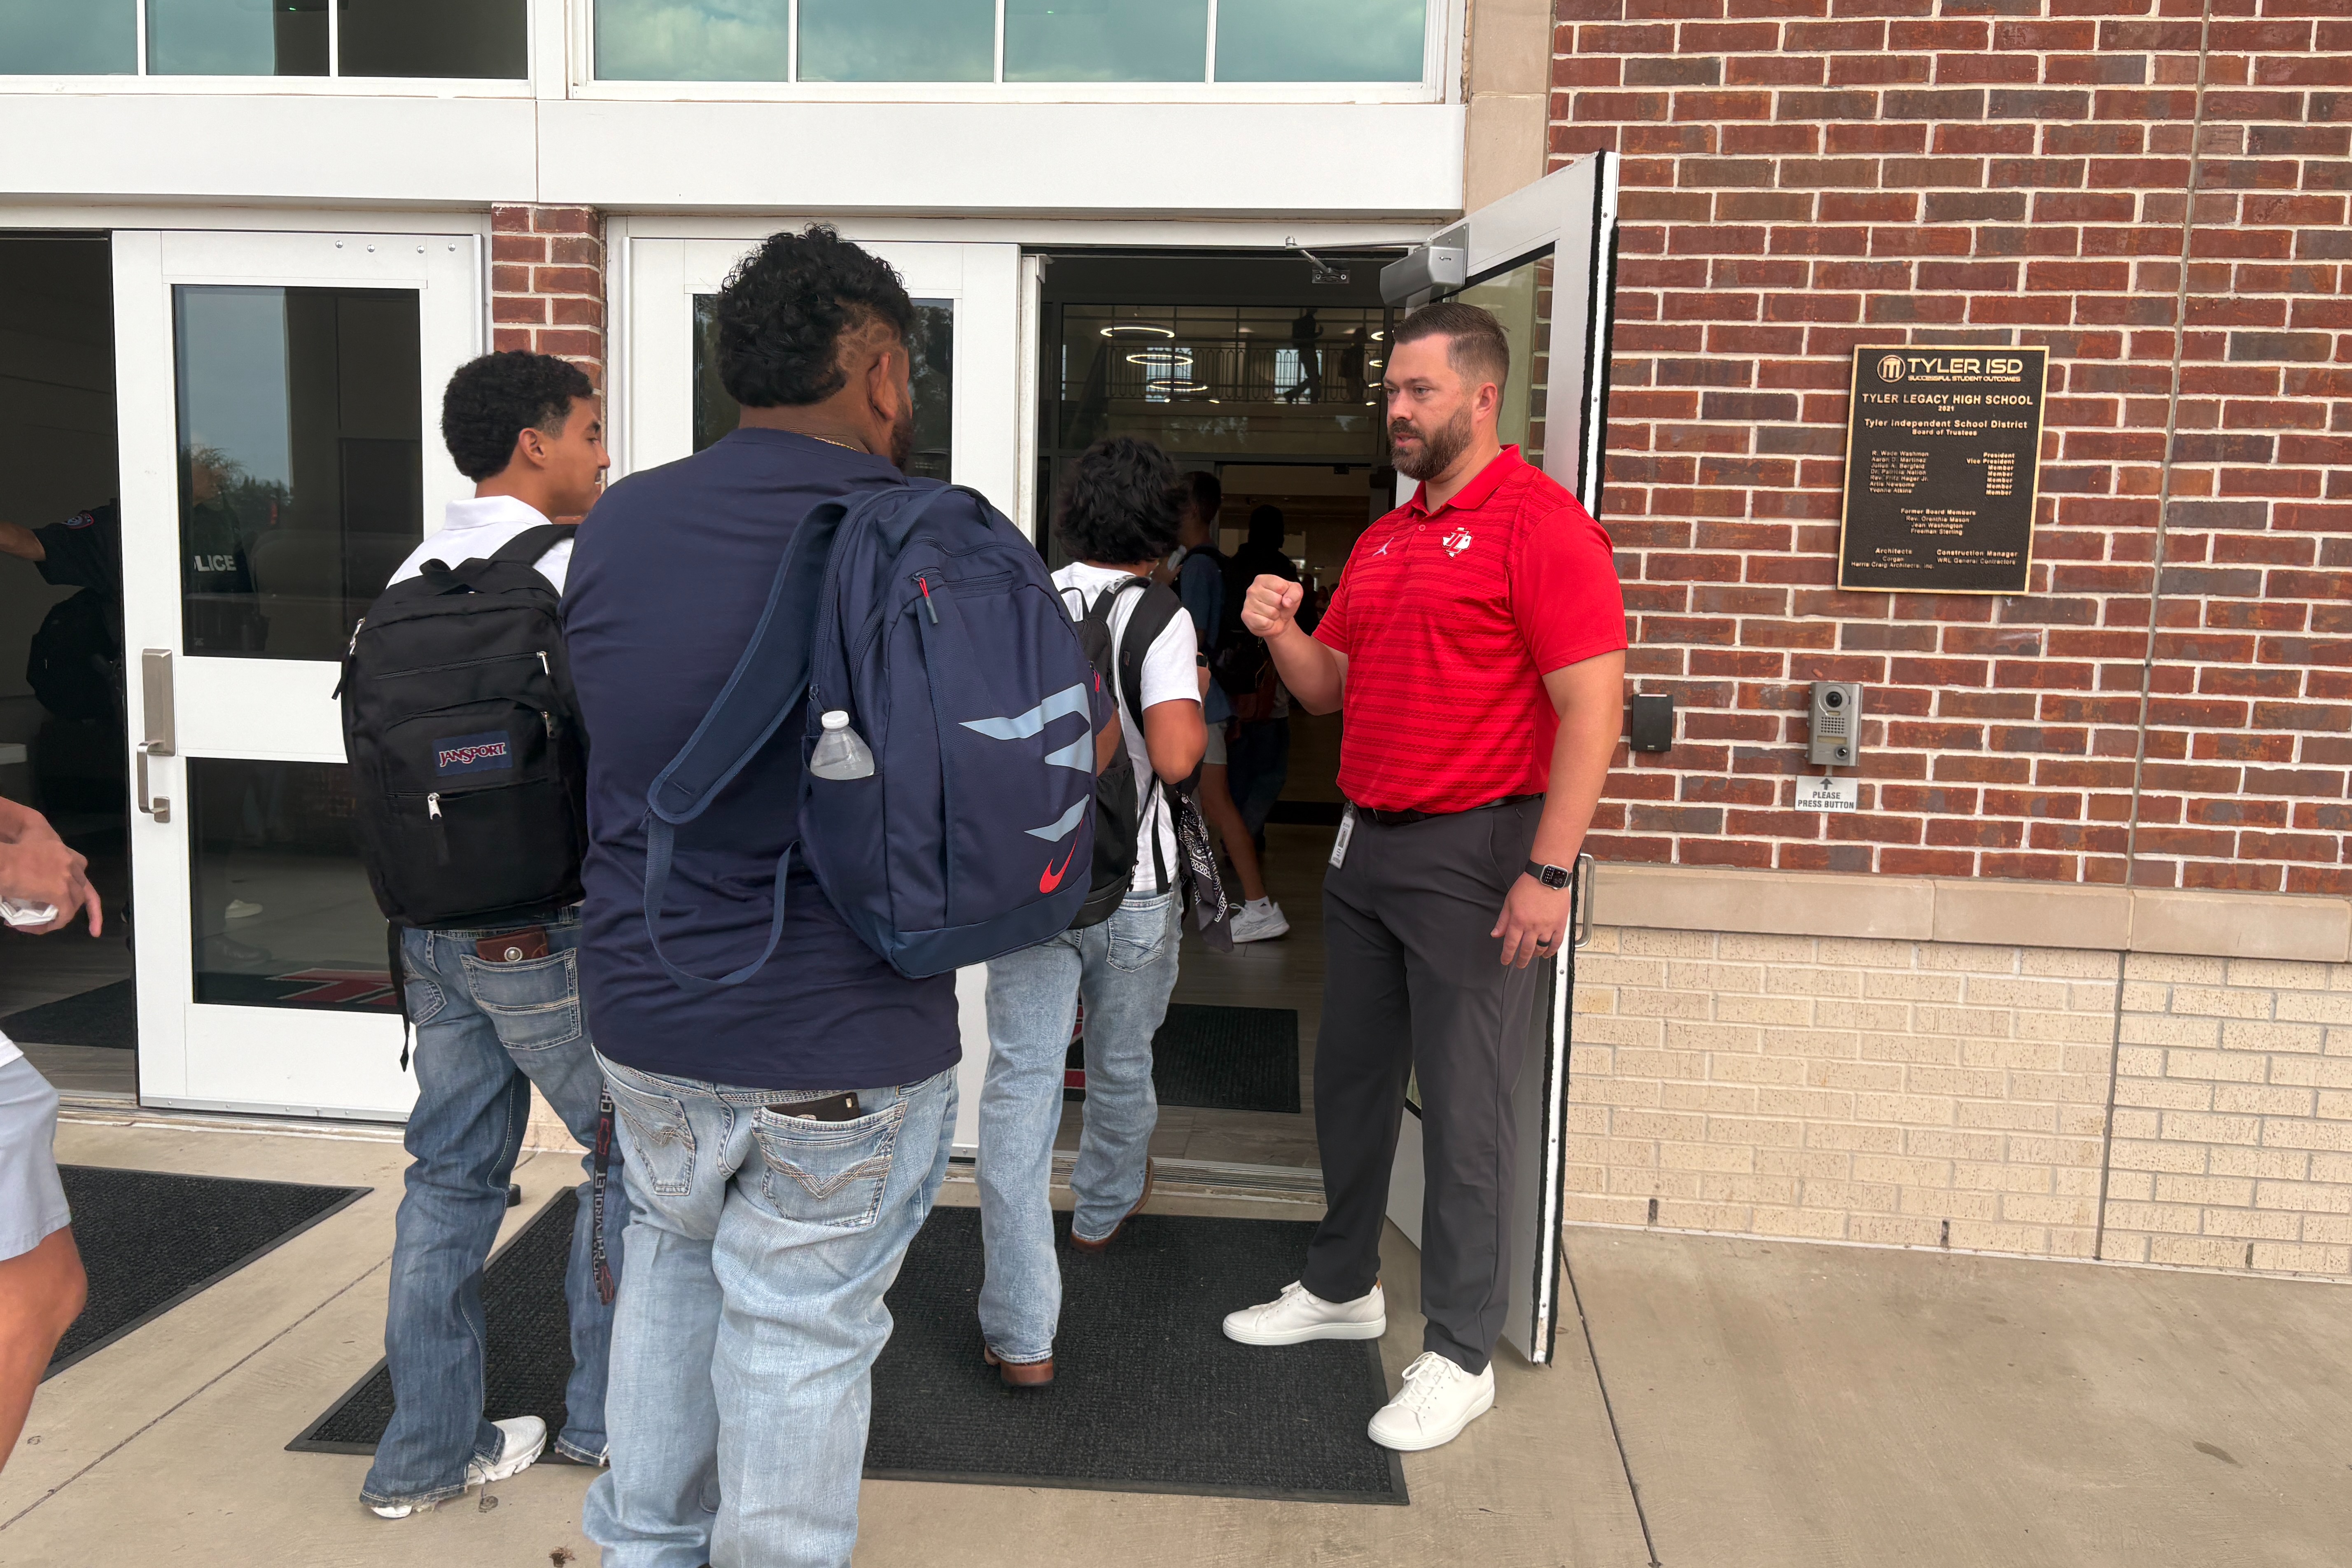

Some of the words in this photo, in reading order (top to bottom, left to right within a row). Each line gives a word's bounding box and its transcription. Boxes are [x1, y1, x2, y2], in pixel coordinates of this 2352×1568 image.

[1907, 358, 1980, 373] TYLER
[1986, 359, 2023, 374] ISD
[1862, 393, 1898, 404] TYLER
[1903, 394, 1948, 404] LEGACY
[1953, 394, 1981, 404] HIGH
[1985, 395, 2033, 405] SCHOOL
[1864, 418, 1888, 428] Tyler
[1891, 419, 1951, 428] Independent
[1954, 420, 1987, 428] School
[1991, 420, 2028, 429] District
[194, 555, 237, 572] LICE
[439, 742, 505, 767] JANSPORT
